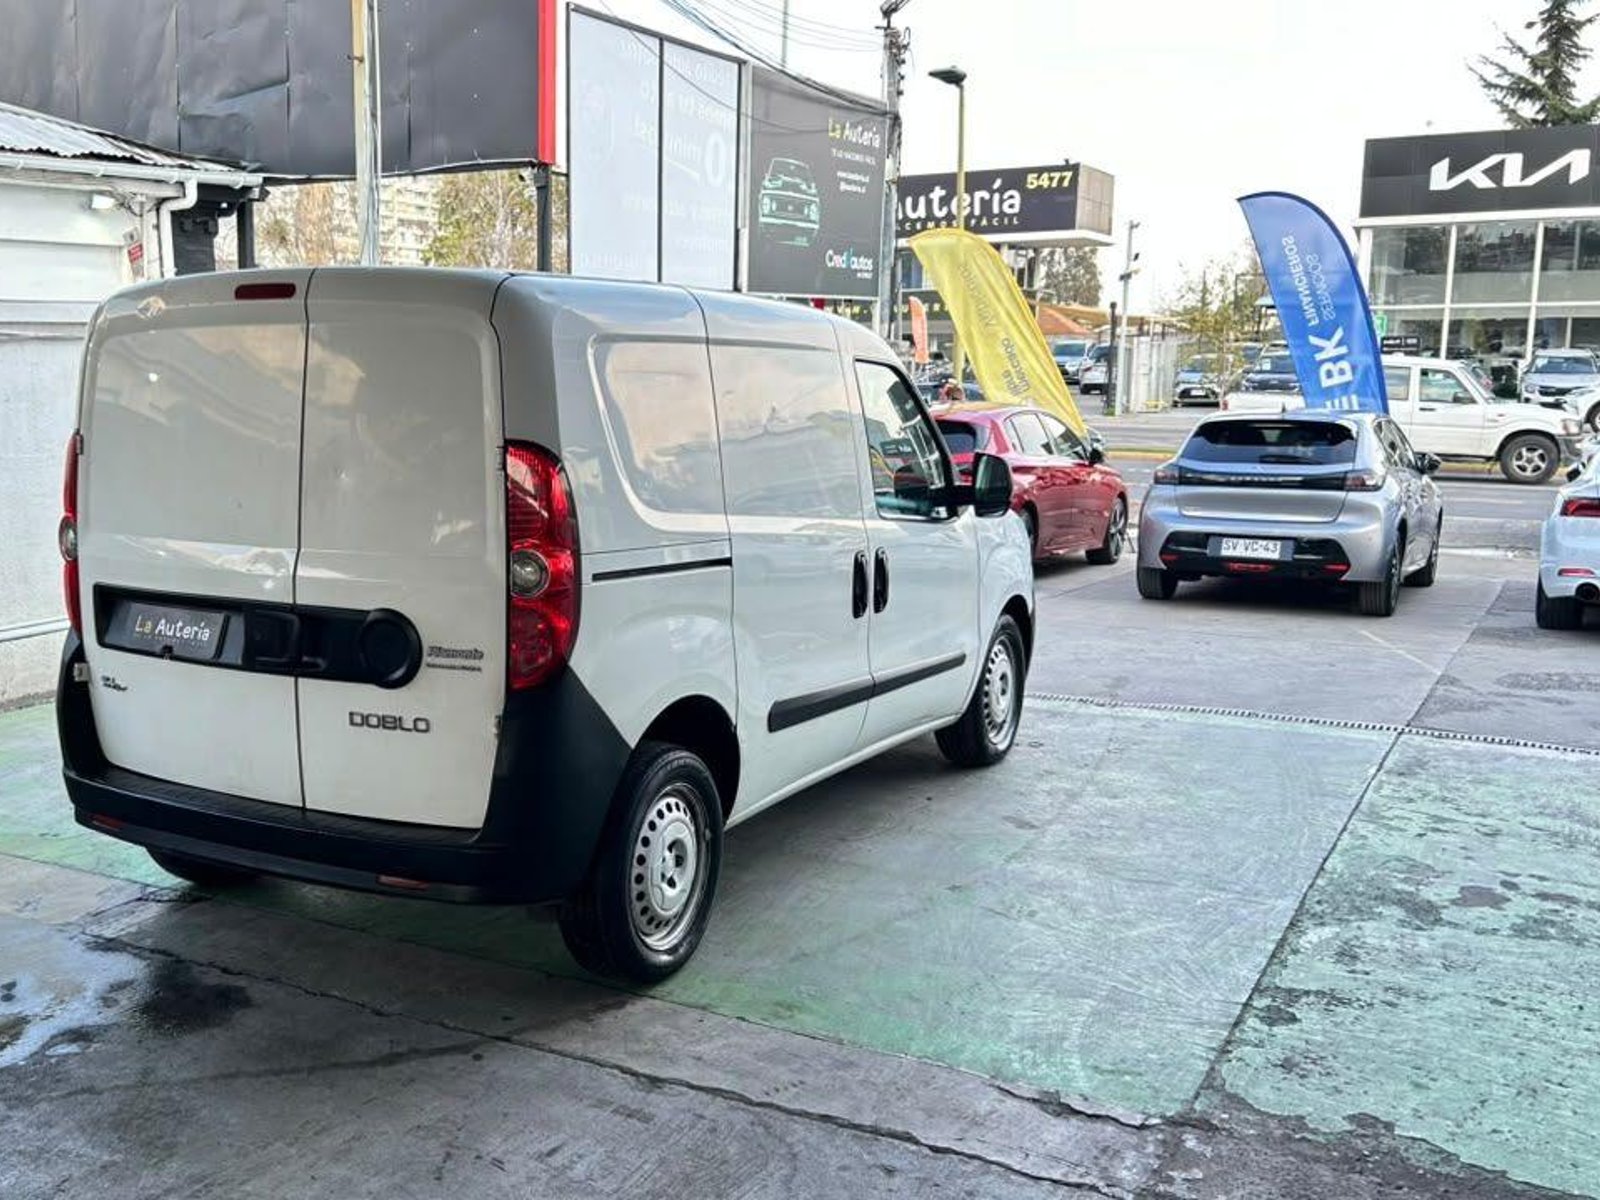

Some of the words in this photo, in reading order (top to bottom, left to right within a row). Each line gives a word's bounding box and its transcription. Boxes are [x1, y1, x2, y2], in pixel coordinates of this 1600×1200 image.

[828, 118, 841, 139] La
[1026, 171, 1073, 189] 5477
[1429, 148, 1591, 191] KIA
[135, 615, 151, 633] La
[154, 618, 210, 641] Autería
[349, 711, 431, 733] DOBLO
